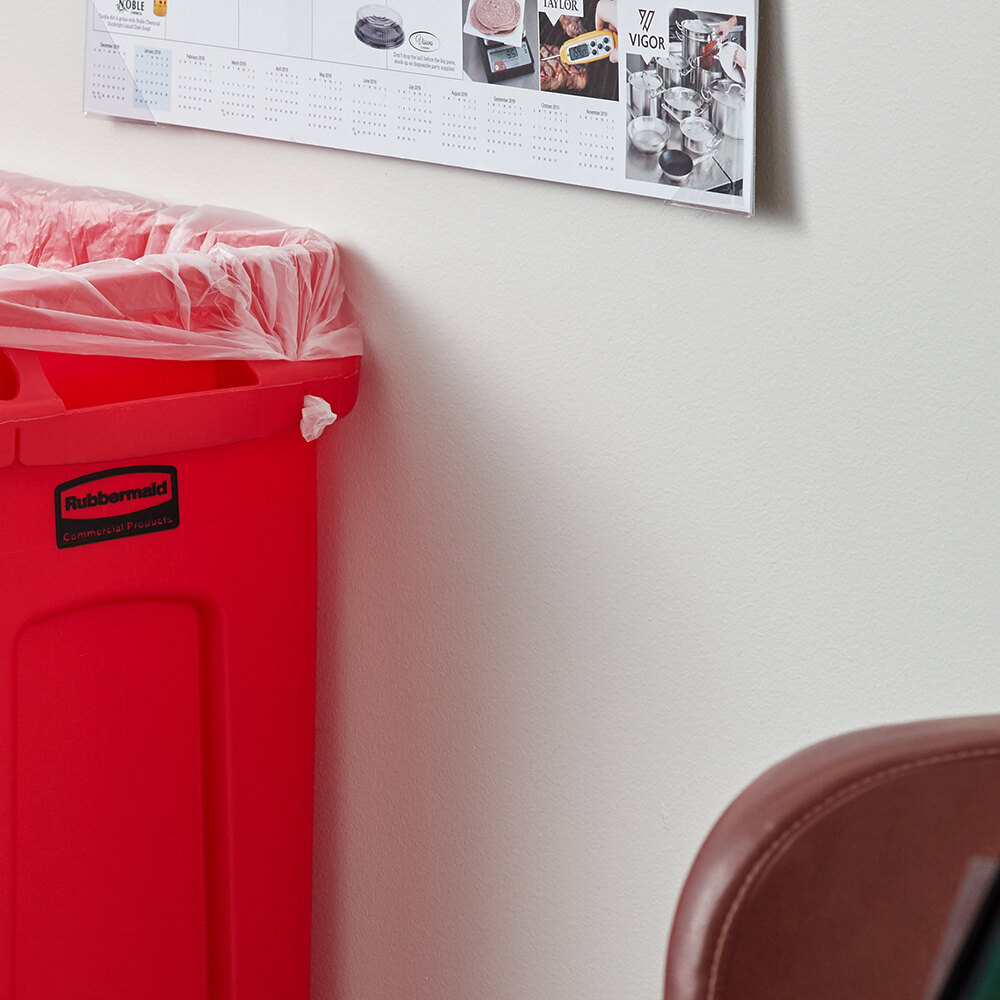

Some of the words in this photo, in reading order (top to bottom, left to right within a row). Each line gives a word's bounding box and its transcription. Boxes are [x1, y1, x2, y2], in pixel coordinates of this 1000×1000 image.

[629, 32, 665, 50] VIGOR
[65, 480, 168, 511] Rubbermaid
[63, 522, 125, 542] Commercial
[127, 516, 174, 531] Products
